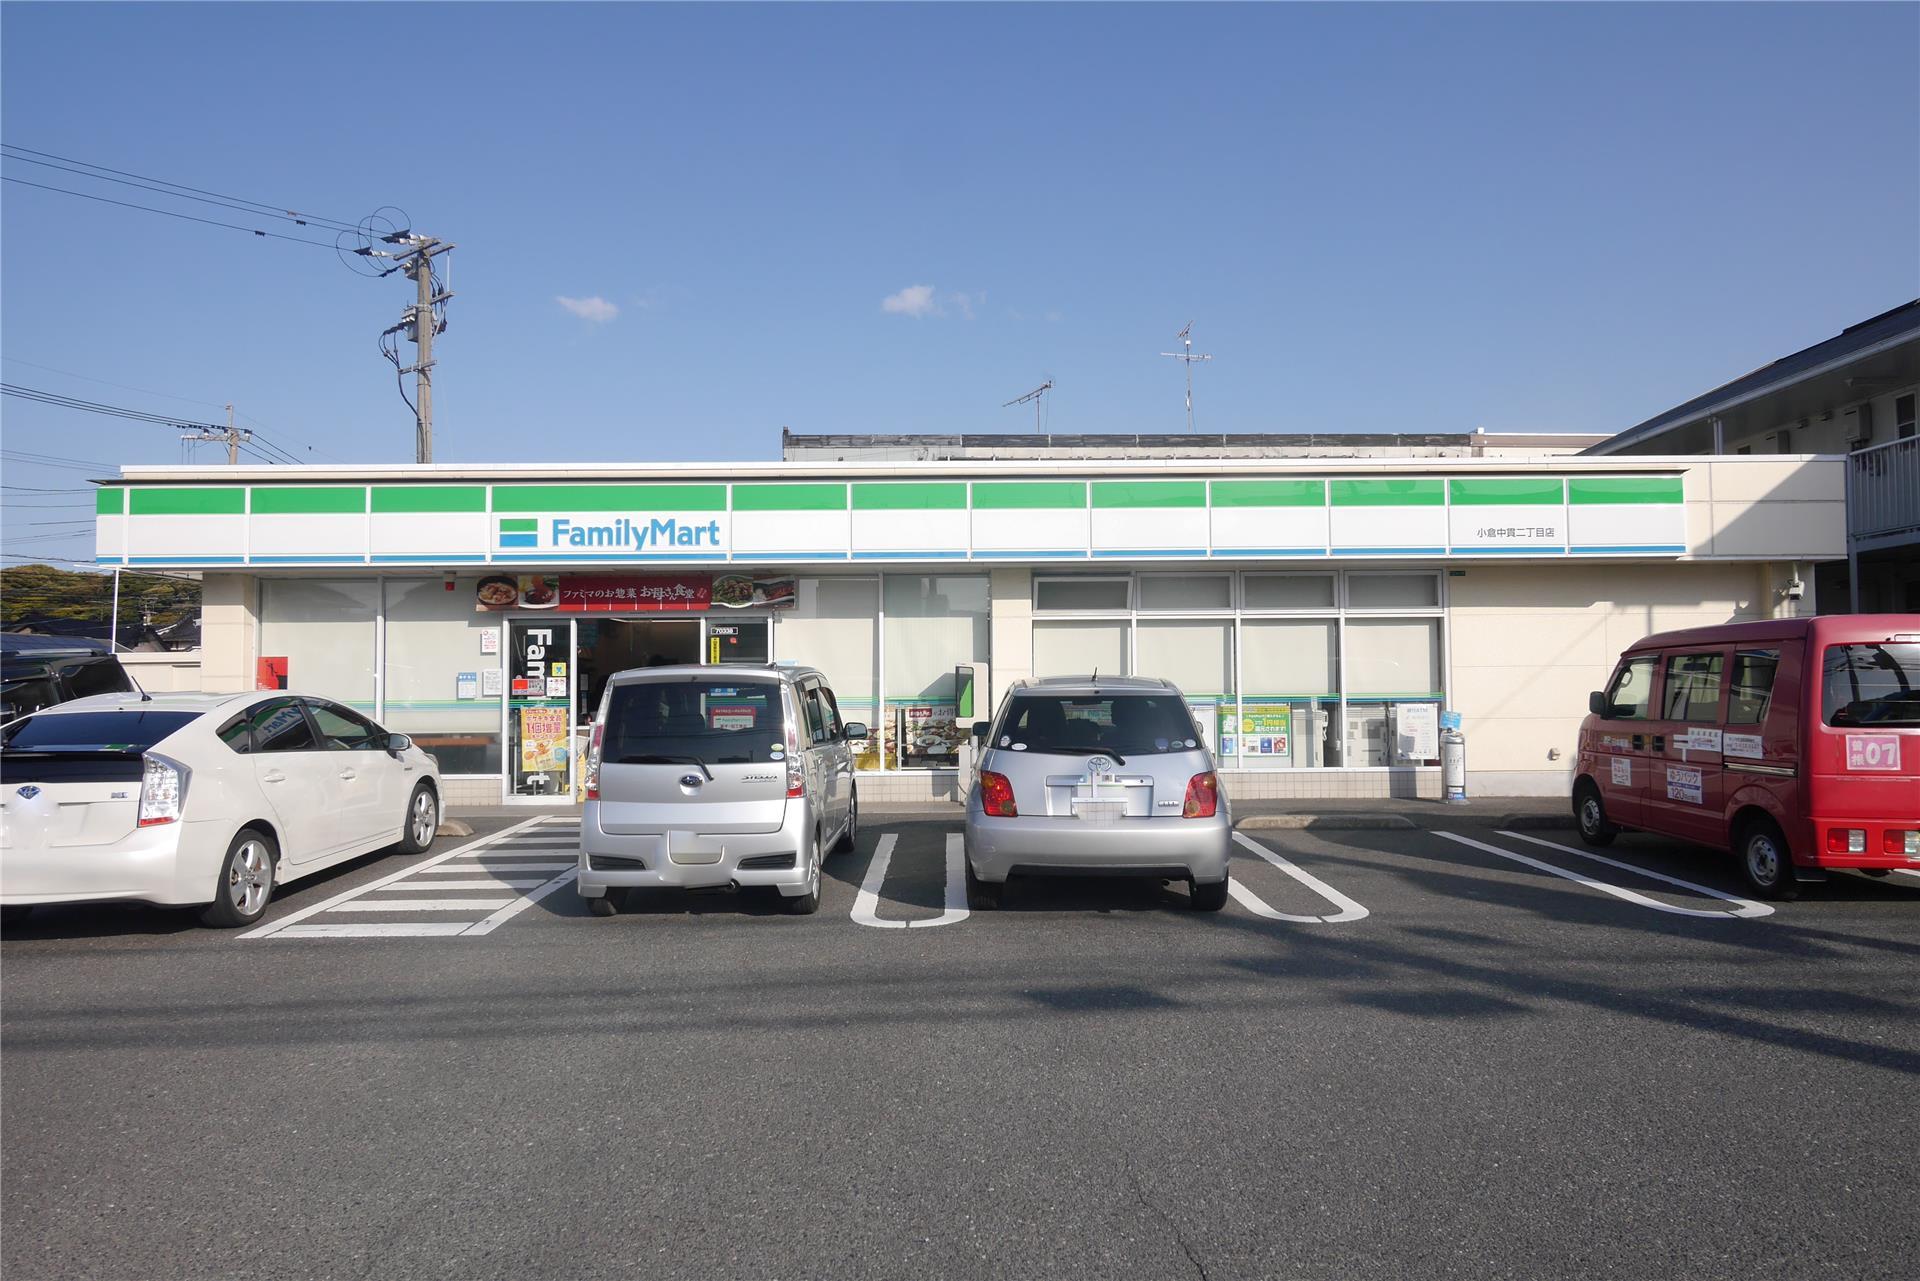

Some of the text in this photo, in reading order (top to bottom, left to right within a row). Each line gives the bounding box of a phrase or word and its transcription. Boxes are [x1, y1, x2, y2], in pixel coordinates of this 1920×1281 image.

[552, 518, 720, 551] FamilyMart
[1476, 527, 1555, 538] 小倉中貫二丁目店
[563, 583, 695, 601] ファミマのお惣菜 お母さん食堂
[1865, 742, 1896, 765] 07
